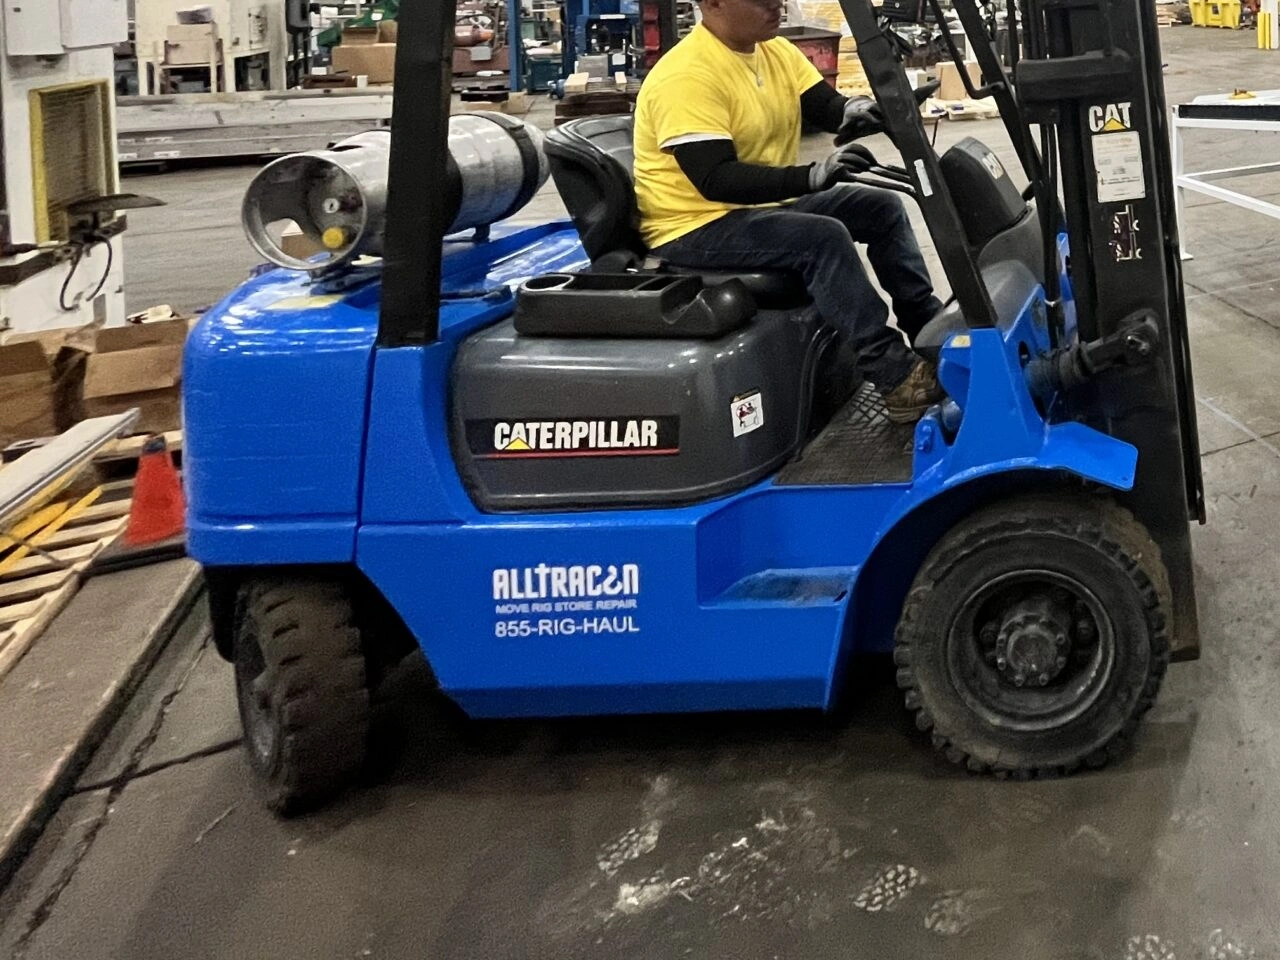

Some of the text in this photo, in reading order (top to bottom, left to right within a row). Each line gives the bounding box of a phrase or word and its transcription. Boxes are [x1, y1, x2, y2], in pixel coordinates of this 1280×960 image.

[1089, 102, 1131, 132] CAT
[494, 420, 658, 450] CATERPILLAR
[495, 599, 638, 614] MOVE RIG STORE REPAIR
[495, 616, 640, 637] 855-RIG-HAUL
